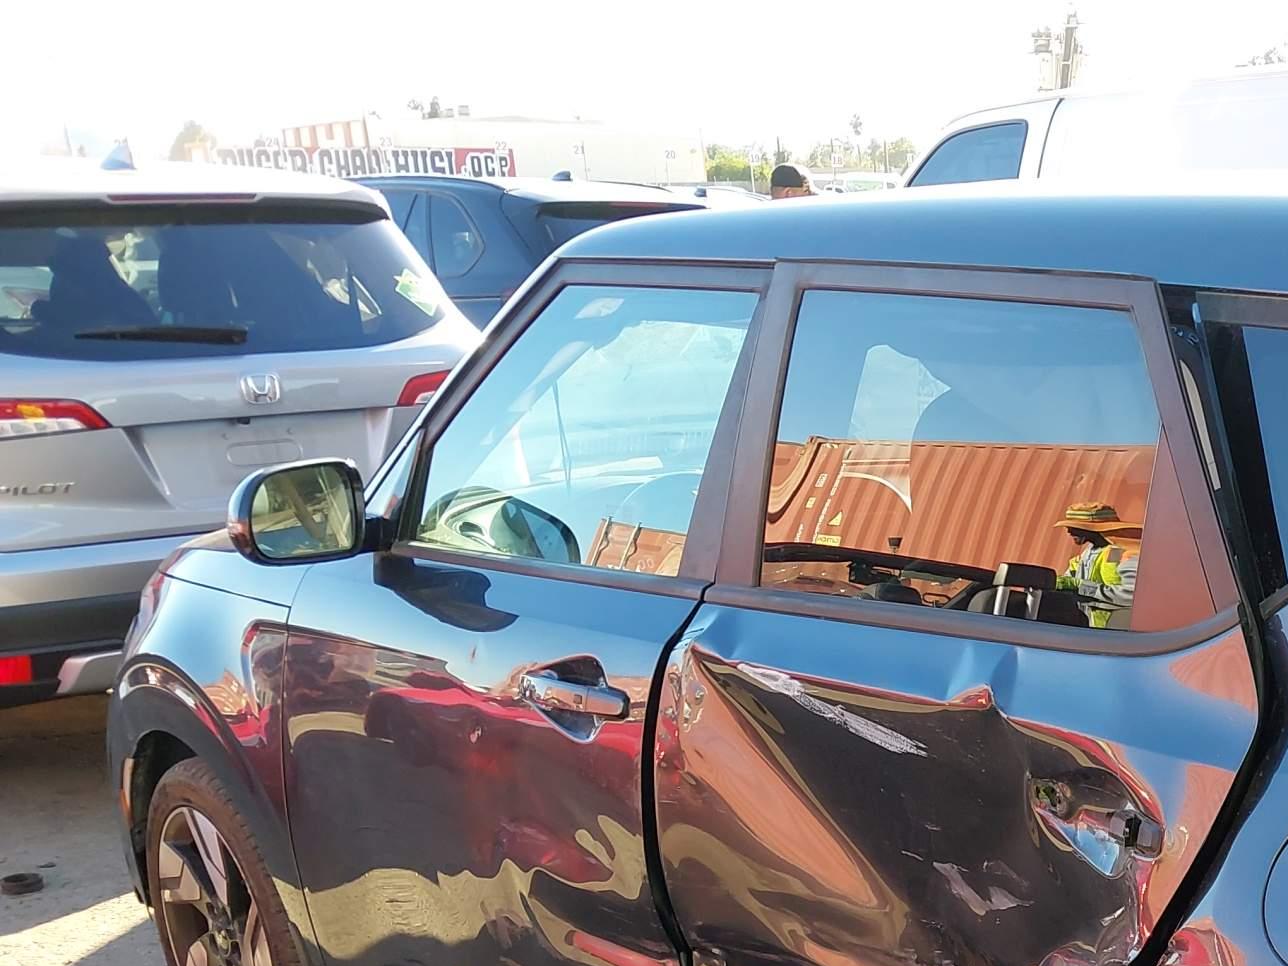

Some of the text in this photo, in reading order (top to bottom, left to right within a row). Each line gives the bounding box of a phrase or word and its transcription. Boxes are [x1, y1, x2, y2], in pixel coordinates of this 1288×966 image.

[380, 137, 393, 147] 23
[495, 140, 508, 151] 22
[664, 149, 676, 160] 20
[0, 481, 76, 497] PILOT
